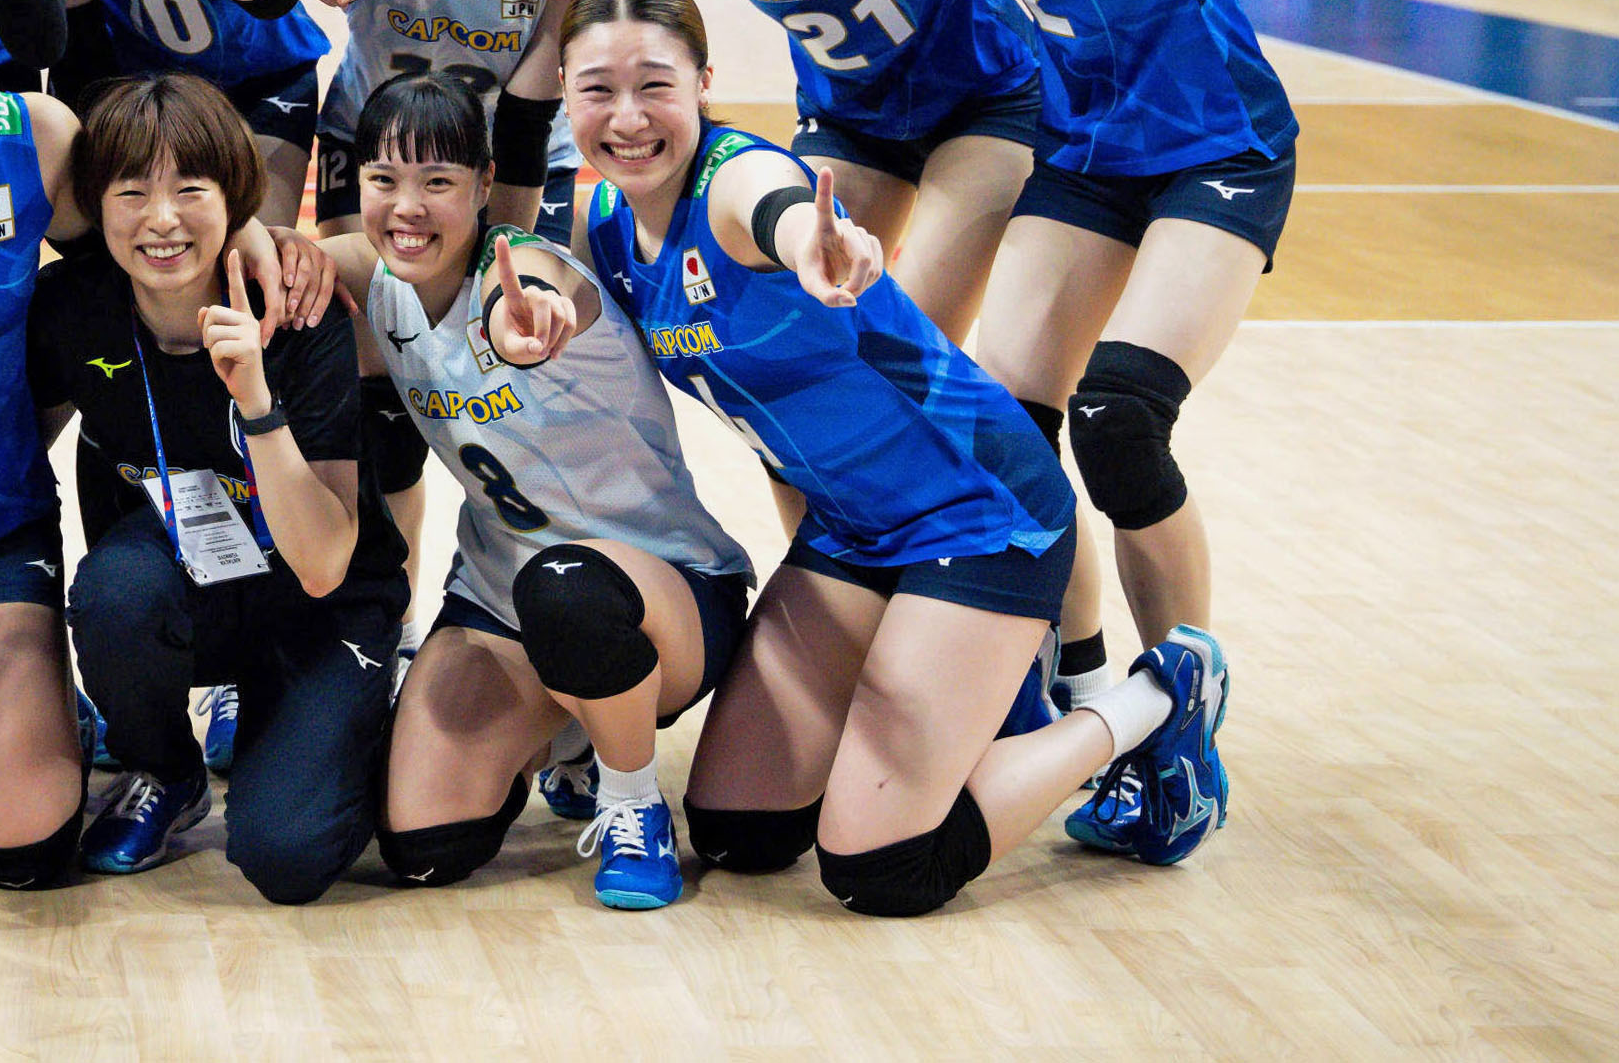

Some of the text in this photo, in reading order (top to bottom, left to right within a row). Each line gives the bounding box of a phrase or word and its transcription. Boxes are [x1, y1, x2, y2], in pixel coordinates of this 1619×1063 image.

[386, 8, 523, 53] CAPCOM
[319, 149, 348, 193] 12
[459, 442, 552, 534] 8
